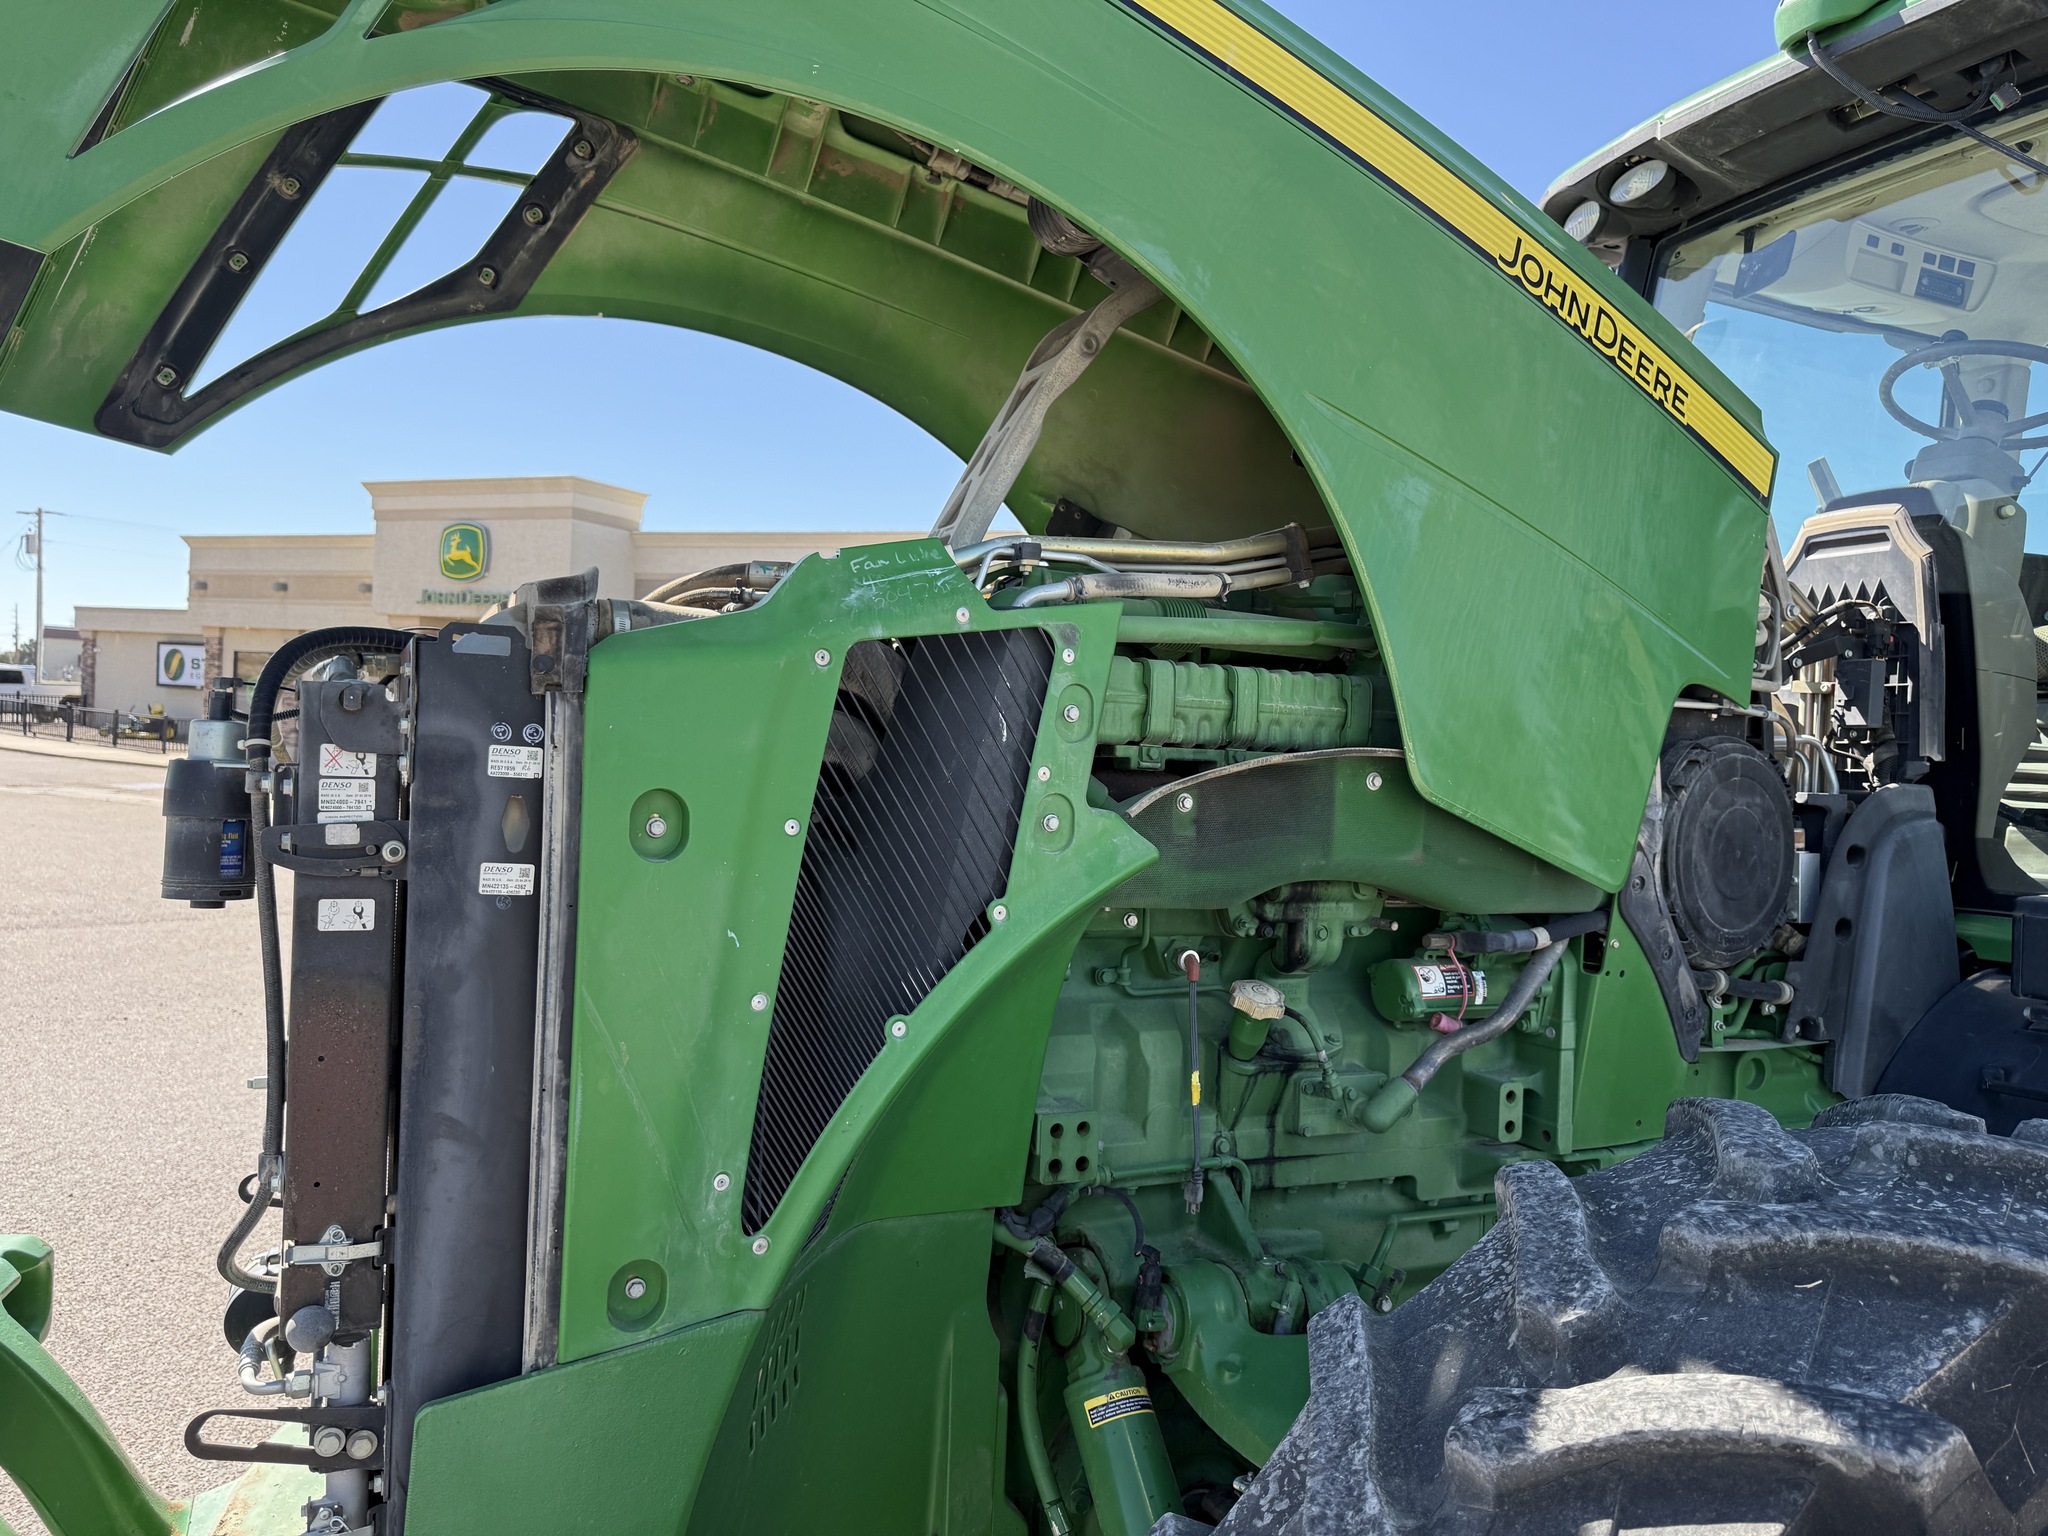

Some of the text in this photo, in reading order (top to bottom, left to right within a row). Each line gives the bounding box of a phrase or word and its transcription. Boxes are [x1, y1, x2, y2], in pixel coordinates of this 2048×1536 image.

[491, 747, 521, 756] DENSO
[483, 865, 514, 873] DENSO
[1115, 1389, 1141, 1398] CAUTION
